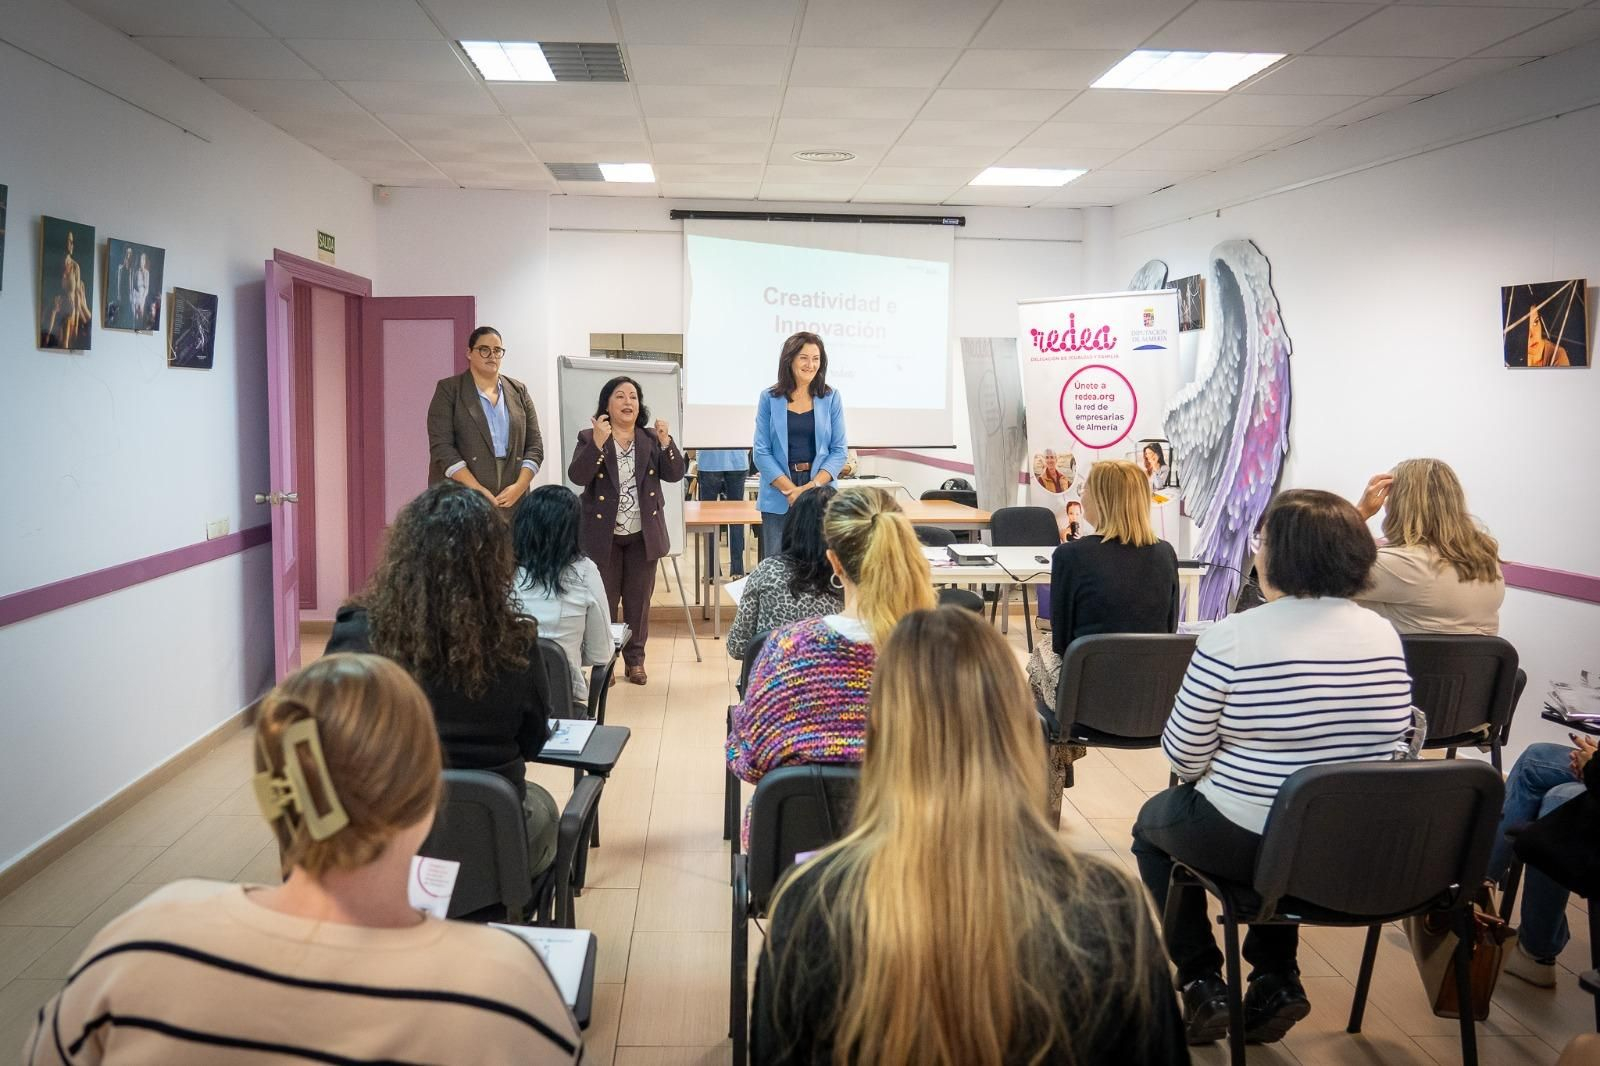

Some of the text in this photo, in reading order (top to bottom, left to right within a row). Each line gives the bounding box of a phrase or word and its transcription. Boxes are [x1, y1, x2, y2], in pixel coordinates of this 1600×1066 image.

[319, 233, 334, 251] SALIDA
[763, 286, 897, 314] Creatividad e
[775, 314, 887, 340] Innovación
[1030, 312, 1118, 353] redea
[1074, 380, 1099, 389] Únete
[1075, 393, 1115, 402] redea.org
[1075, 413, 1125, 422] empresarias
[1087, 423, 1118, 431] Almería
